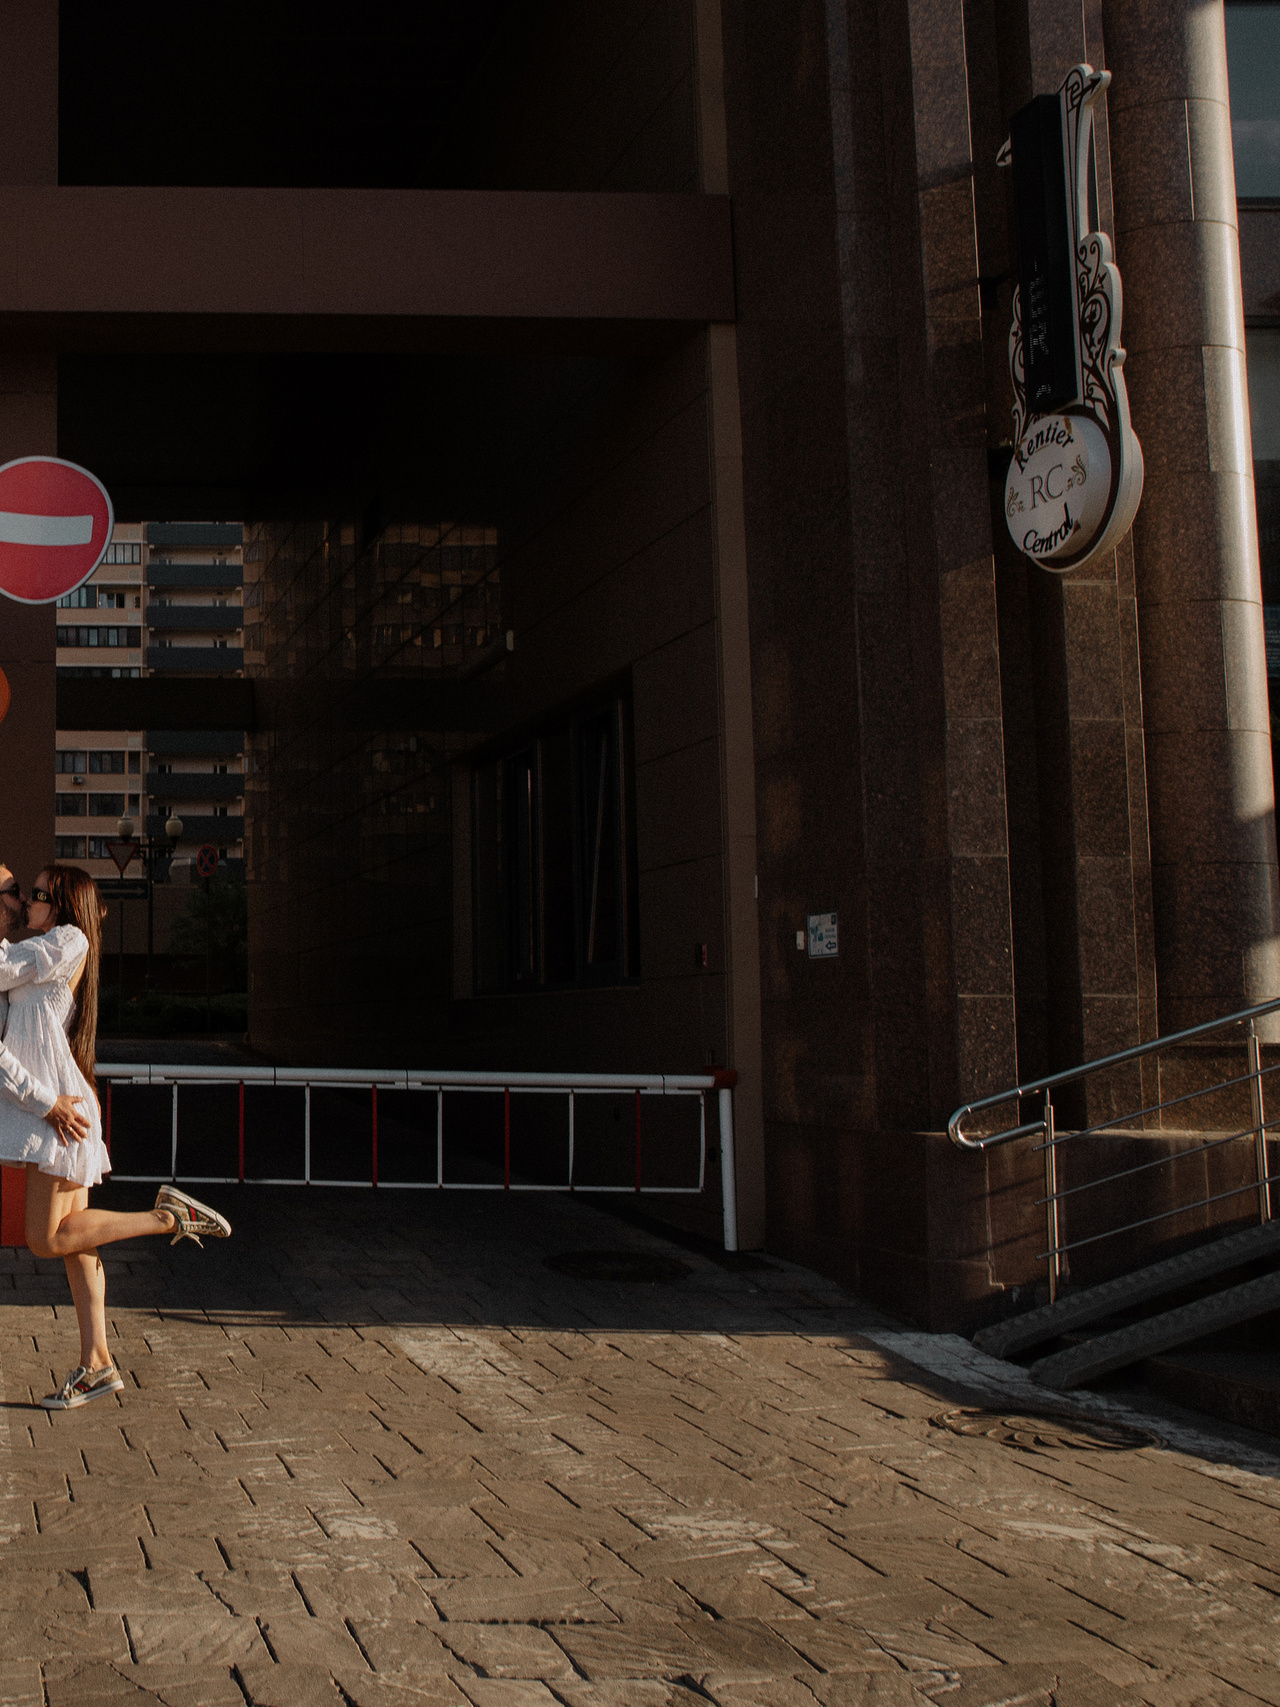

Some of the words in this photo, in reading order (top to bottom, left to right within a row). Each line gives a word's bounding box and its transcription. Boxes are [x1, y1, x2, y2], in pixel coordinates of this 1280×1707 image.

[1015, 421, 1074, 474] Rentier
[1029, 463, 1065, 510] RC
[1022, 502, 1074, 554] Central
